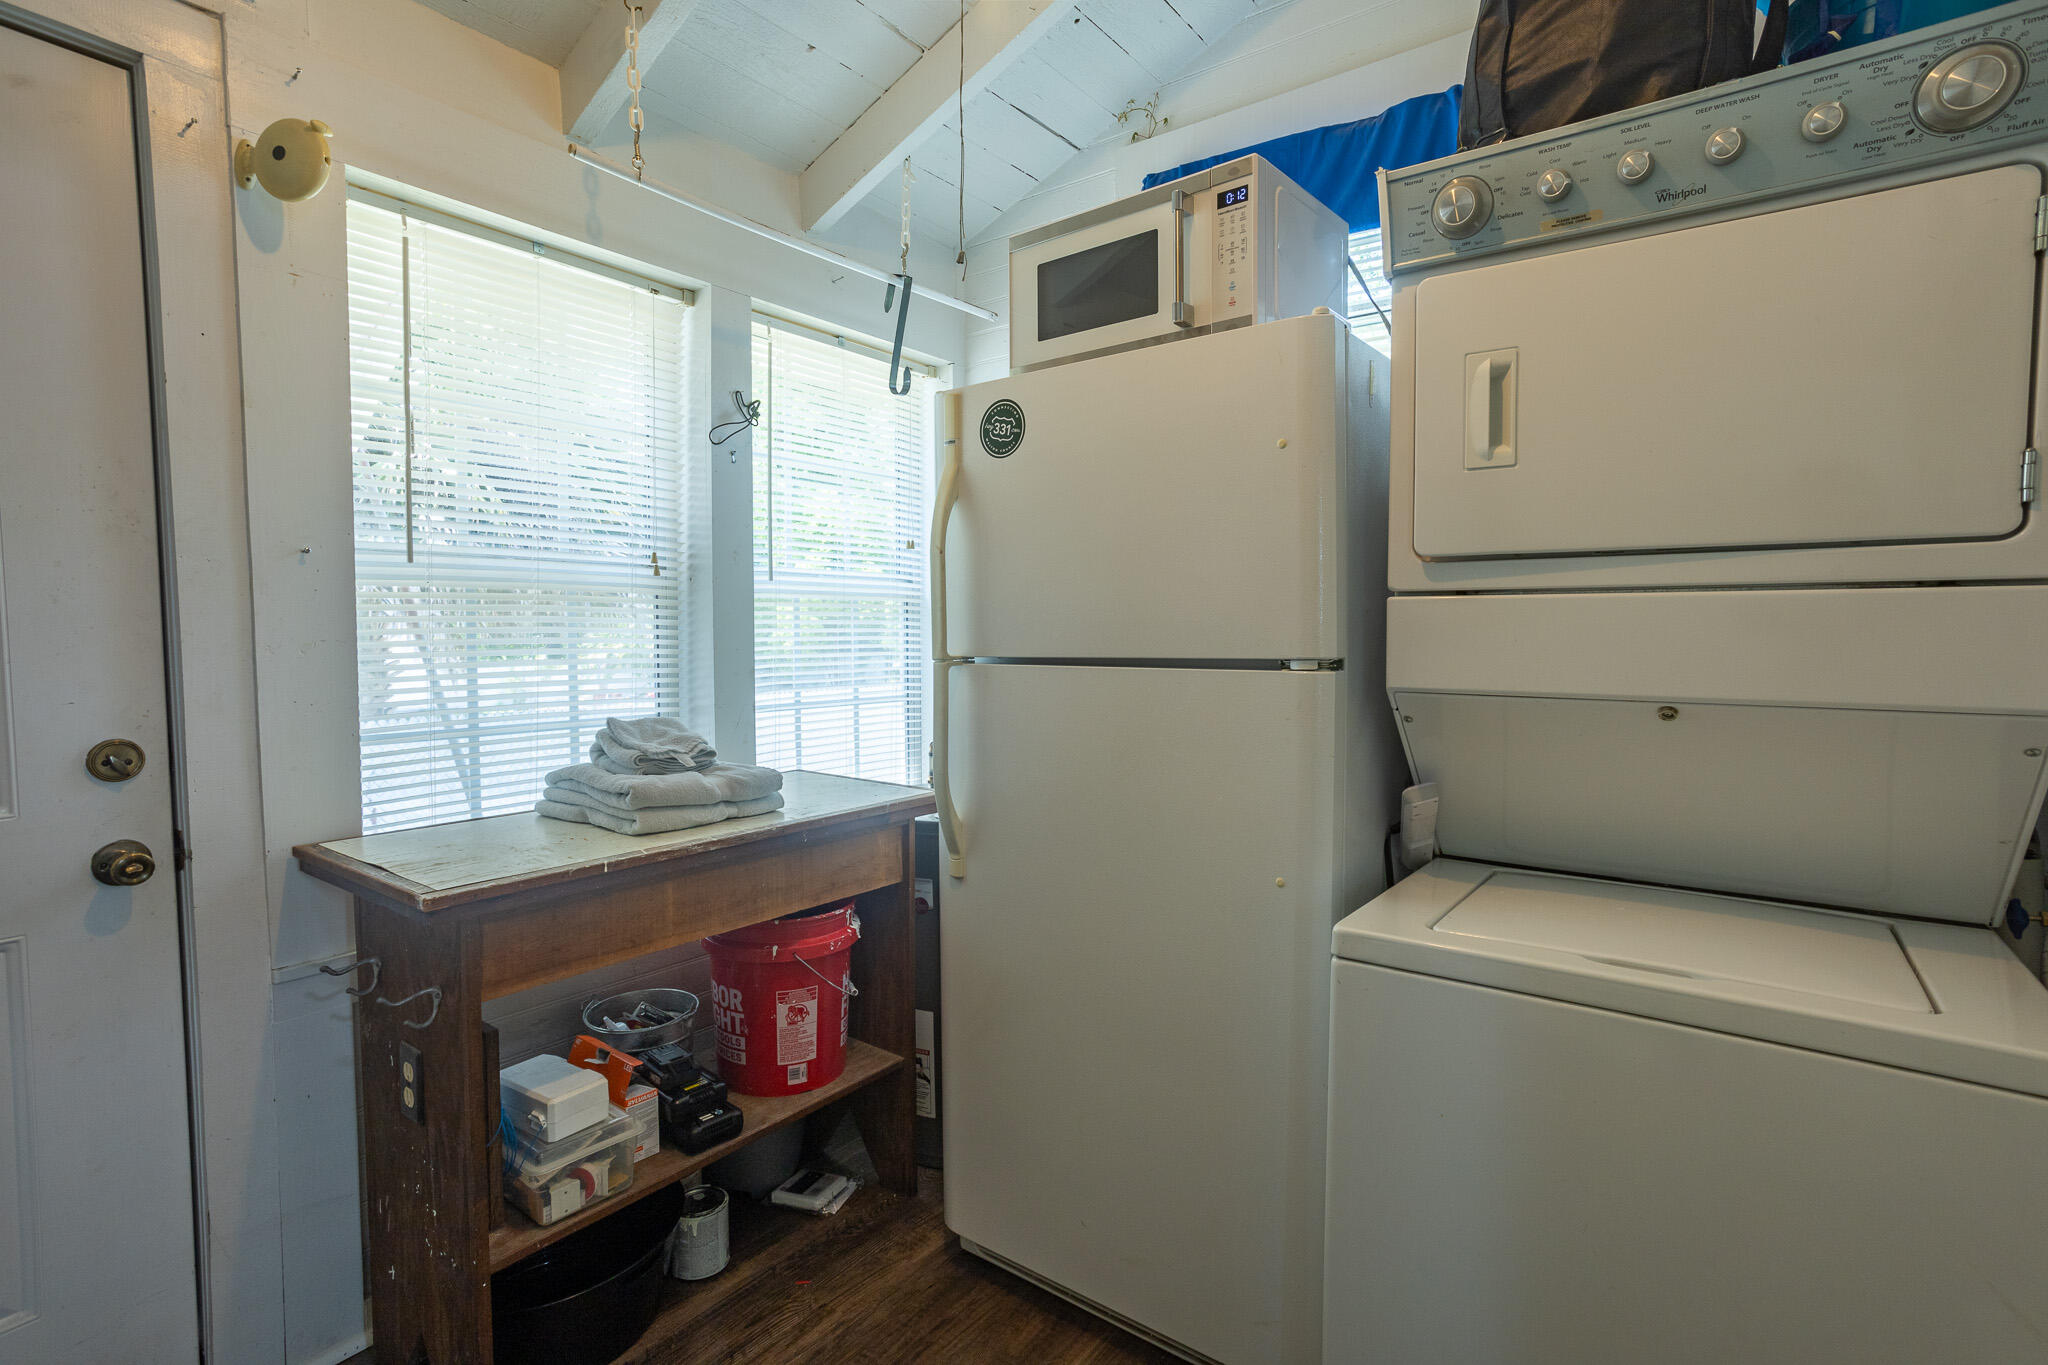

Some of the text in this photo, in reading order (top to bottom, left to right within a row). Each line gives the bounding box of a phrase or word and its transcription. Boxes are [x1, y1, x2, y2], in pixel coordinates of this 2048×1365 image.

[1936, 38, 1955, 46] Cool
[1960, 36, 1977, 45] OFF
[1934, 44, 1957, 53] Down
[1858, 54, 1905, 70] Automatic
[1873, 65, 1889, 75] Dry
[1813, 74, 1839, 84] DRYER
[1882, 79, 1900, 87] Very
[1695, 94, 1761, 115] DEEP WATER WASH
[1894, 101, 1910, 109] OFF
[2014, 97, 2032, 105] OFF
[1870, 117, 1887, 126] Cool
[2006, 119, 2046, 132] Fluff Air
[1619, 123, 1652, 135] SOIL LEVEL
[1624, 136, 1648, 146] Medium
[1655, 138, 1673, 147] Heavy
[1853, 135, 1898, 149] Automatic
[1893, 140, 1908, 149] Very
[1538, 142, 1573, 155] WASH TEMP
[1866, 145, 1883, 154] Dry
[1602, 152, 1618, 160] Light
[1403, 178, 1425, 187] Normal
[1225, 188, 1246, 204] 0:12
[1656, 183, 1707, 204] Whirlpool
[1497, 211, 1525, 221] Delicates
[1408, 230, 1426, 238] Casual
[993, 423, 1011, 436] 331
[623, 1062, 633, 1073] LED
